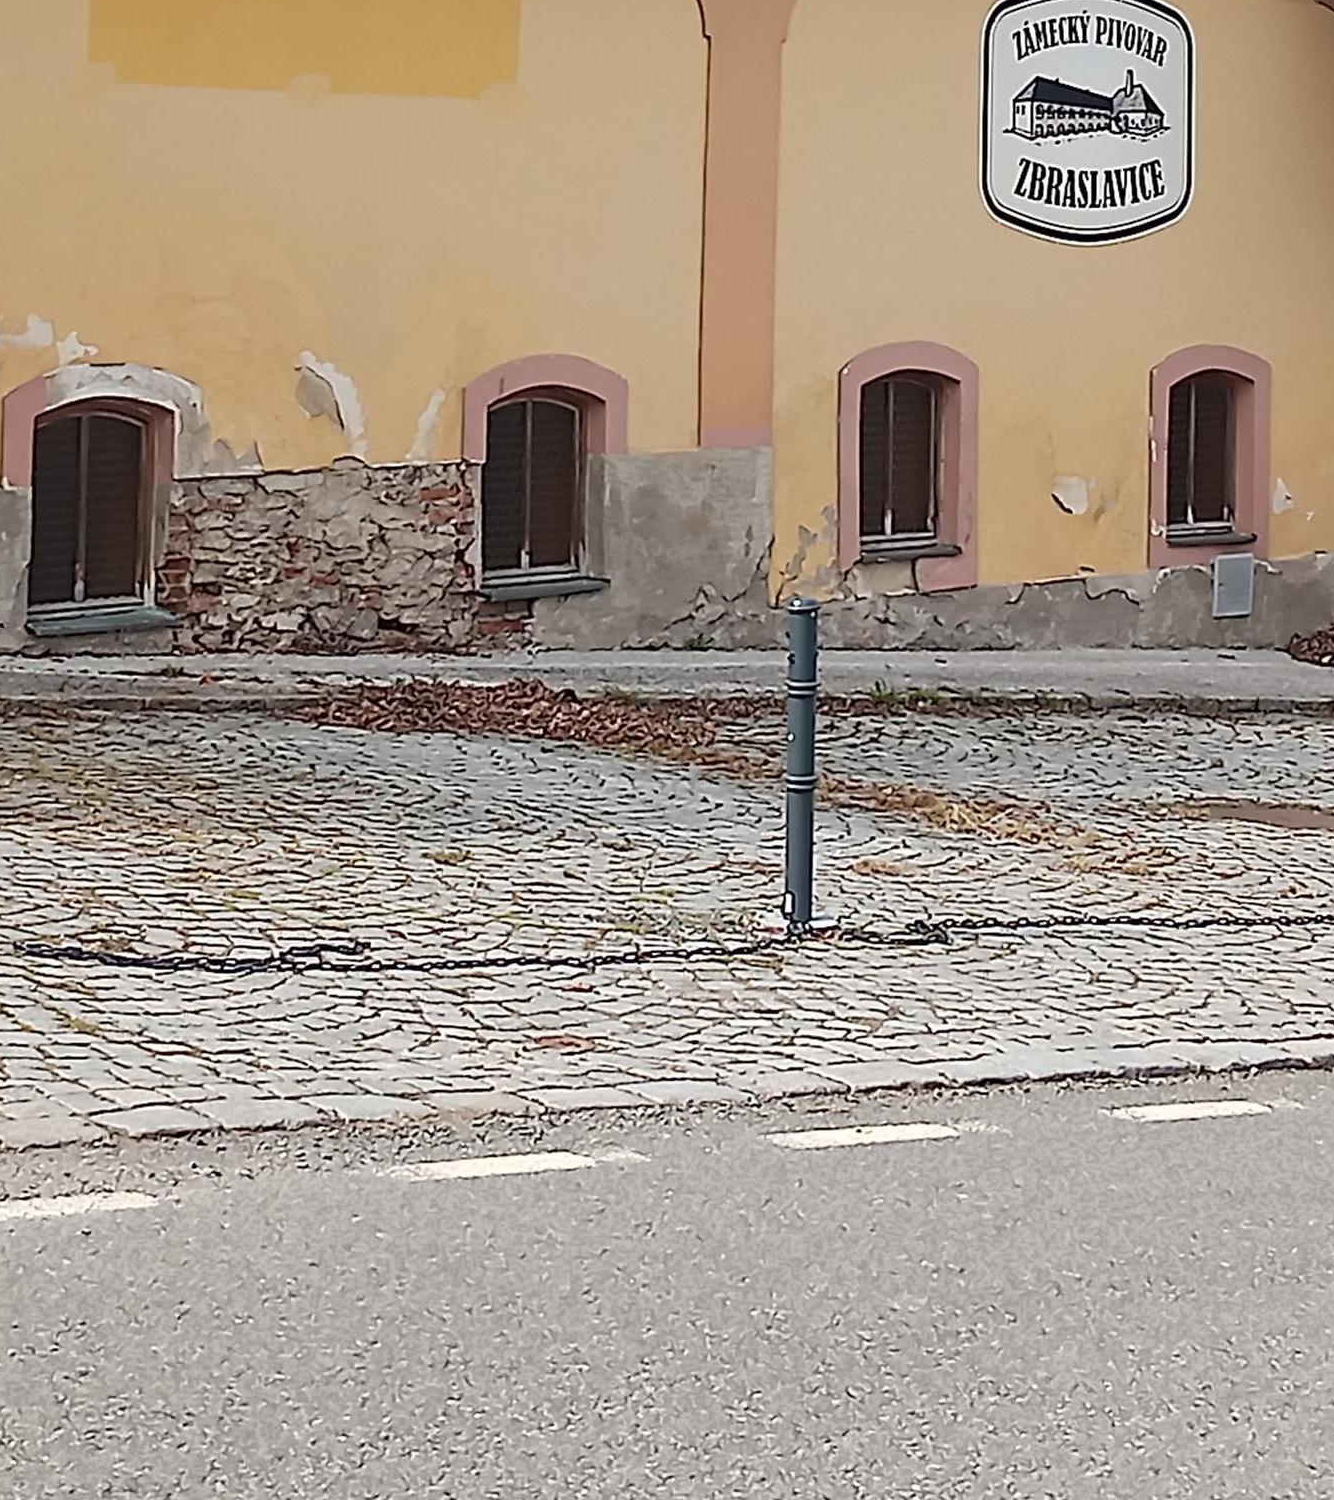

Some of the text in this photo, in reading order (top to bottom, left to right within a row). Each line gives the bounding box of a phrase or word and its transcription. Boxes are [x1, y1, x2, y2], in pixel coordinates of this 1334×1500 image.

[1012, 10, 1168, 66] ZÁMECKÝ PIVOVAR
[1014, 158, 1165, 208] ZBRASLAVICE
